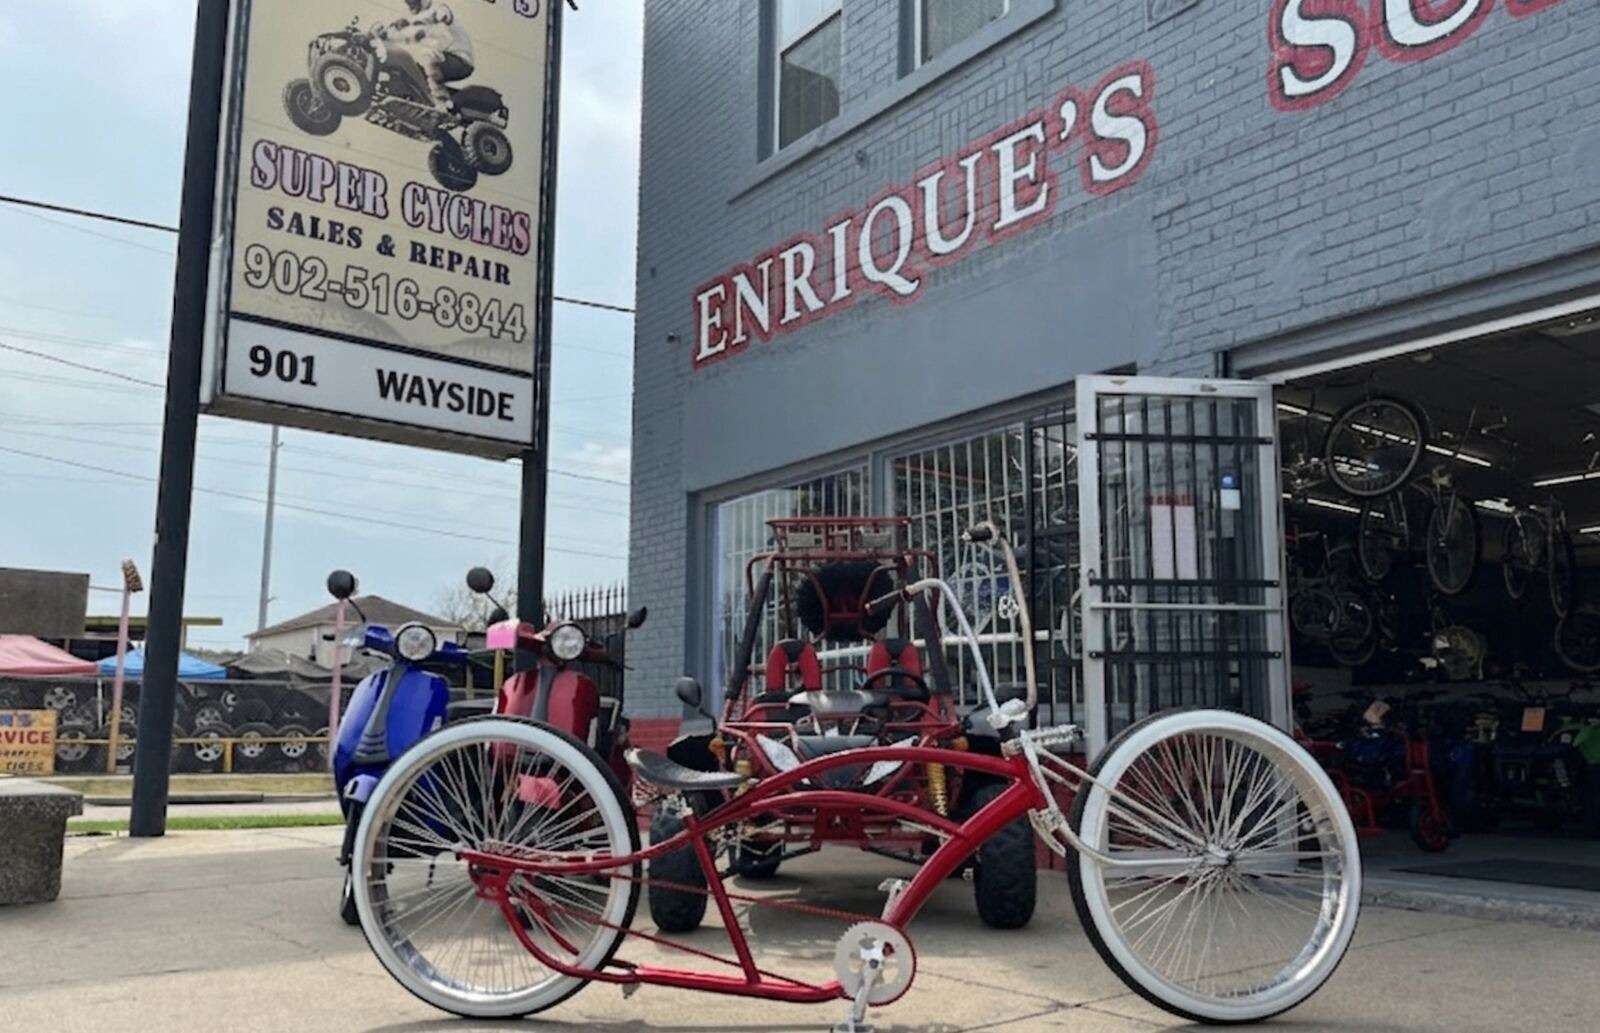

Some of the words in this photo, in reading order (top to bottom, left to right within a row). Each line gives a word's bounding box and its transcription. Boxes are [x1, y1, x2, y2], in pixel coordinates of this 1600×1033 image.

[250, 139, 389, 219] SUPER
[401, 181, 531, 255] CYCLES
[696, 74, 1147, 361] ENRIQUE'S
[267, 207, 363, 249] SALES
[376, 235, 396, 257] &
[409, 241, 511, 285] REPAIR
[244, 243, 527, 342] 902-516-8844
[249, 345, 318, 387] 901
[376, 368, 515, 421] WAYSIDE
[0, 730, 51, 744] VICE
